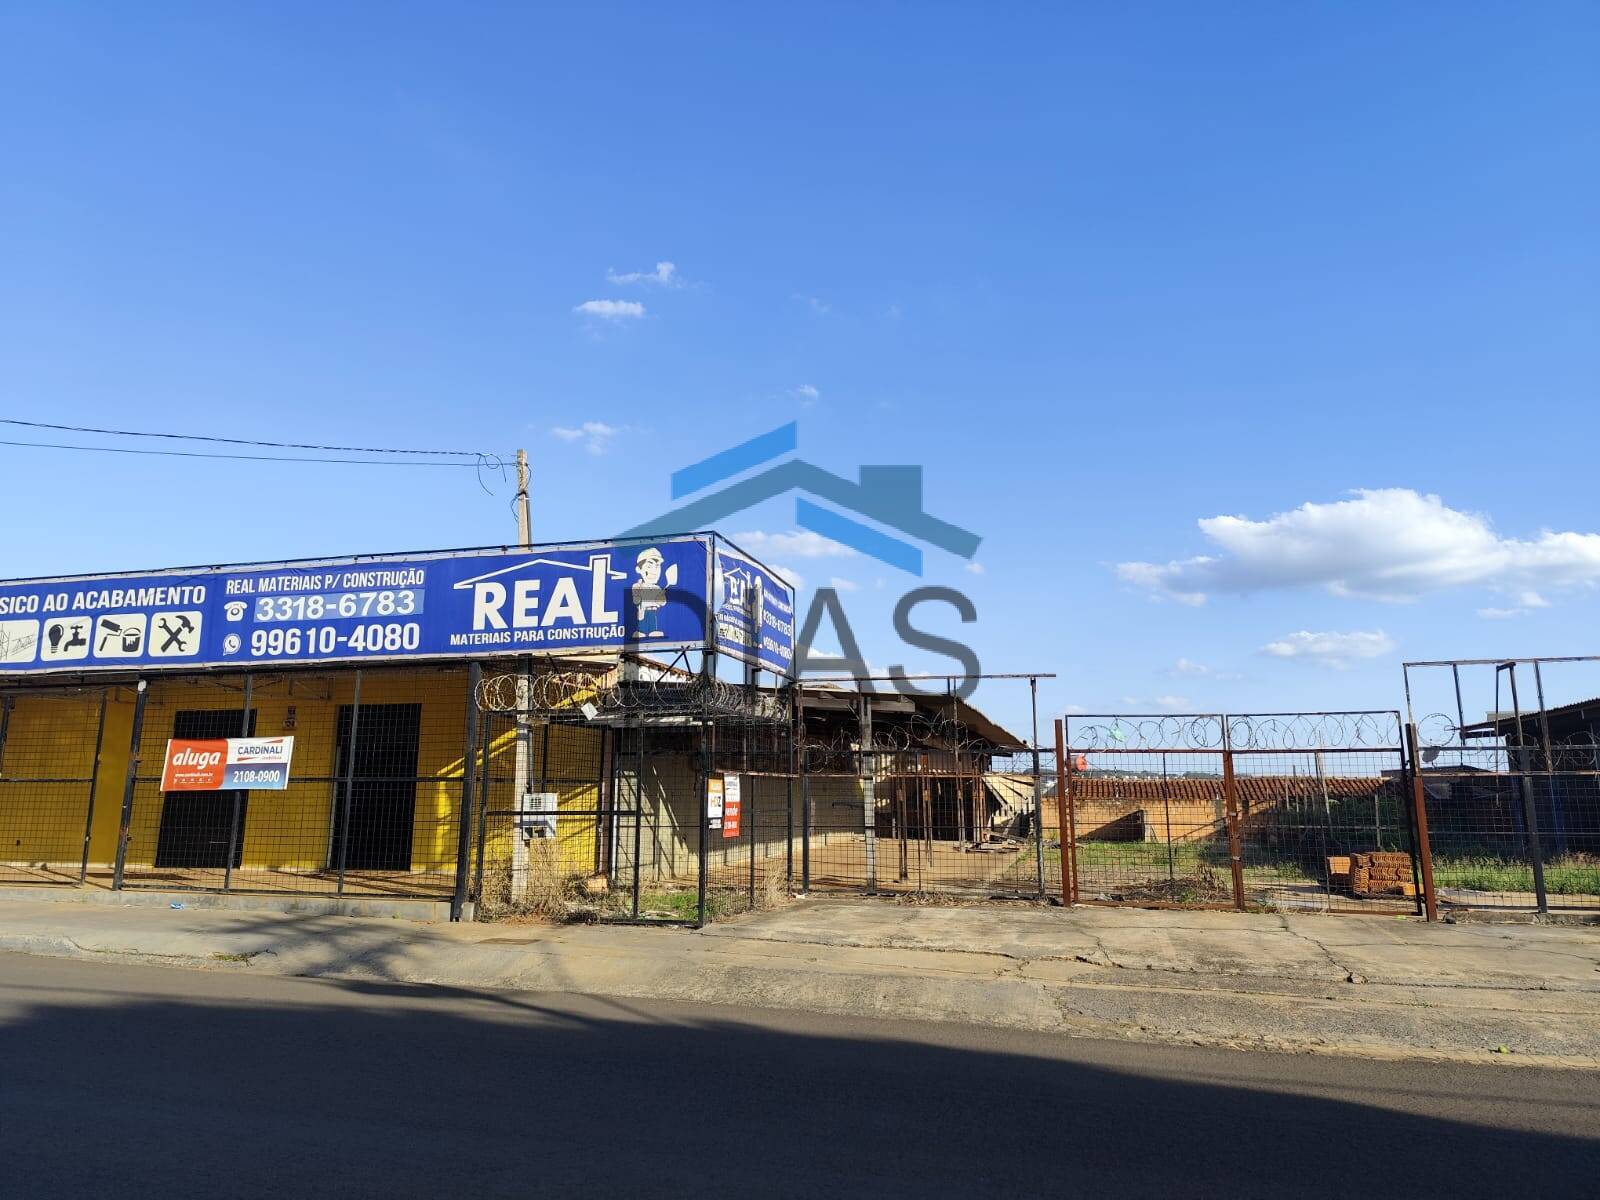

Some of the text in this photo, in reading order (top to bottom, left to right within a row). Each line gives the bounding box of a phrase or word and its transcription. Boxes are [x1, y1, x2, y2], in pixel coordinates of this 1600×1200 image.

[226, 568, 425, 595] REAL MATERIAIS P/ CONSTRUÇÃO
[473, 558, 618, 630] REAL
[0, 585, 206, 615] SICO AO ACABAMENTO
[256, 590, 415, 622] 3318-6783
[251, 622, 420, 656] 99610-4080
[450, 624, 625, 646] MATERIAIS PARA CONSTRUÇÃO
[172, 747, 221, 770] aluga
[238, 746, 283, 755] CARDINALI
[232, 770, 280, 783] 2108-0900
